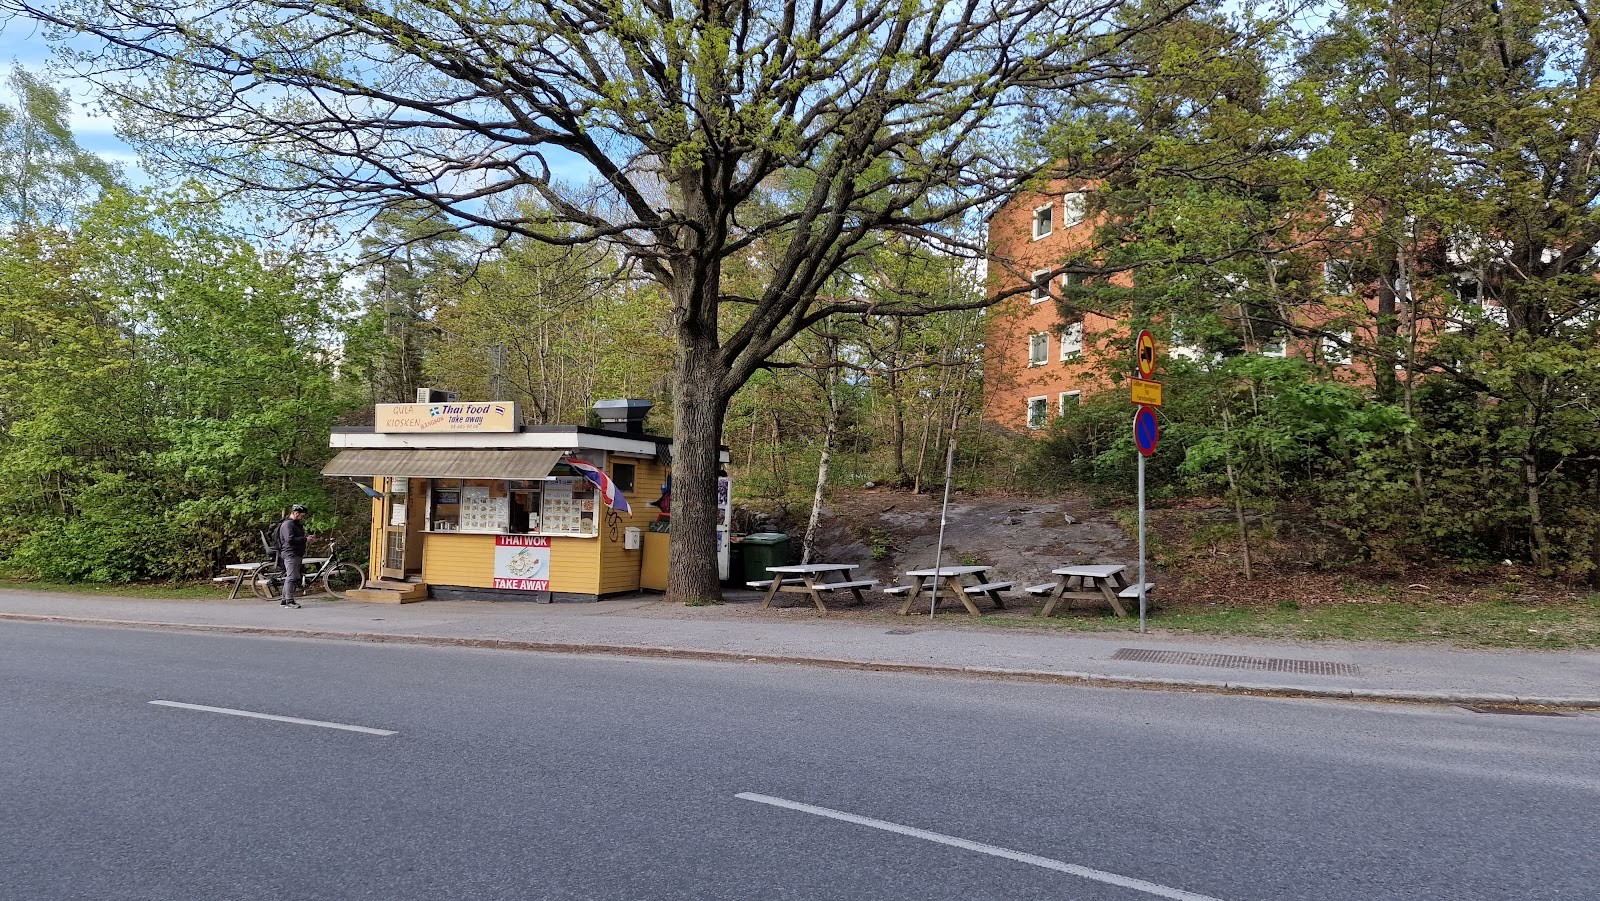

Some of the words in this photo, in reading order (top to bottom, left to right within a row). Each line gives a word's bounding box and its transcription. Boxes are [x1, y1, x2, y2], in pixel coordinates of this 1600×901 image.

[393, 406, 414, 415] GULA
[442, 405, 463, 414] Thai
[466, 404, 491, 414] food
[386, 418, 421, 427] KIOSKEN
[449, 415, 463, 423] take
[465, 416, 483, 426] away
[500, 535, 523, 546] THAI
[524, 536, 548, 546] WOK
[494, 579, 519, 589] TAKE
[520, 580, 548, 591] AWAY
